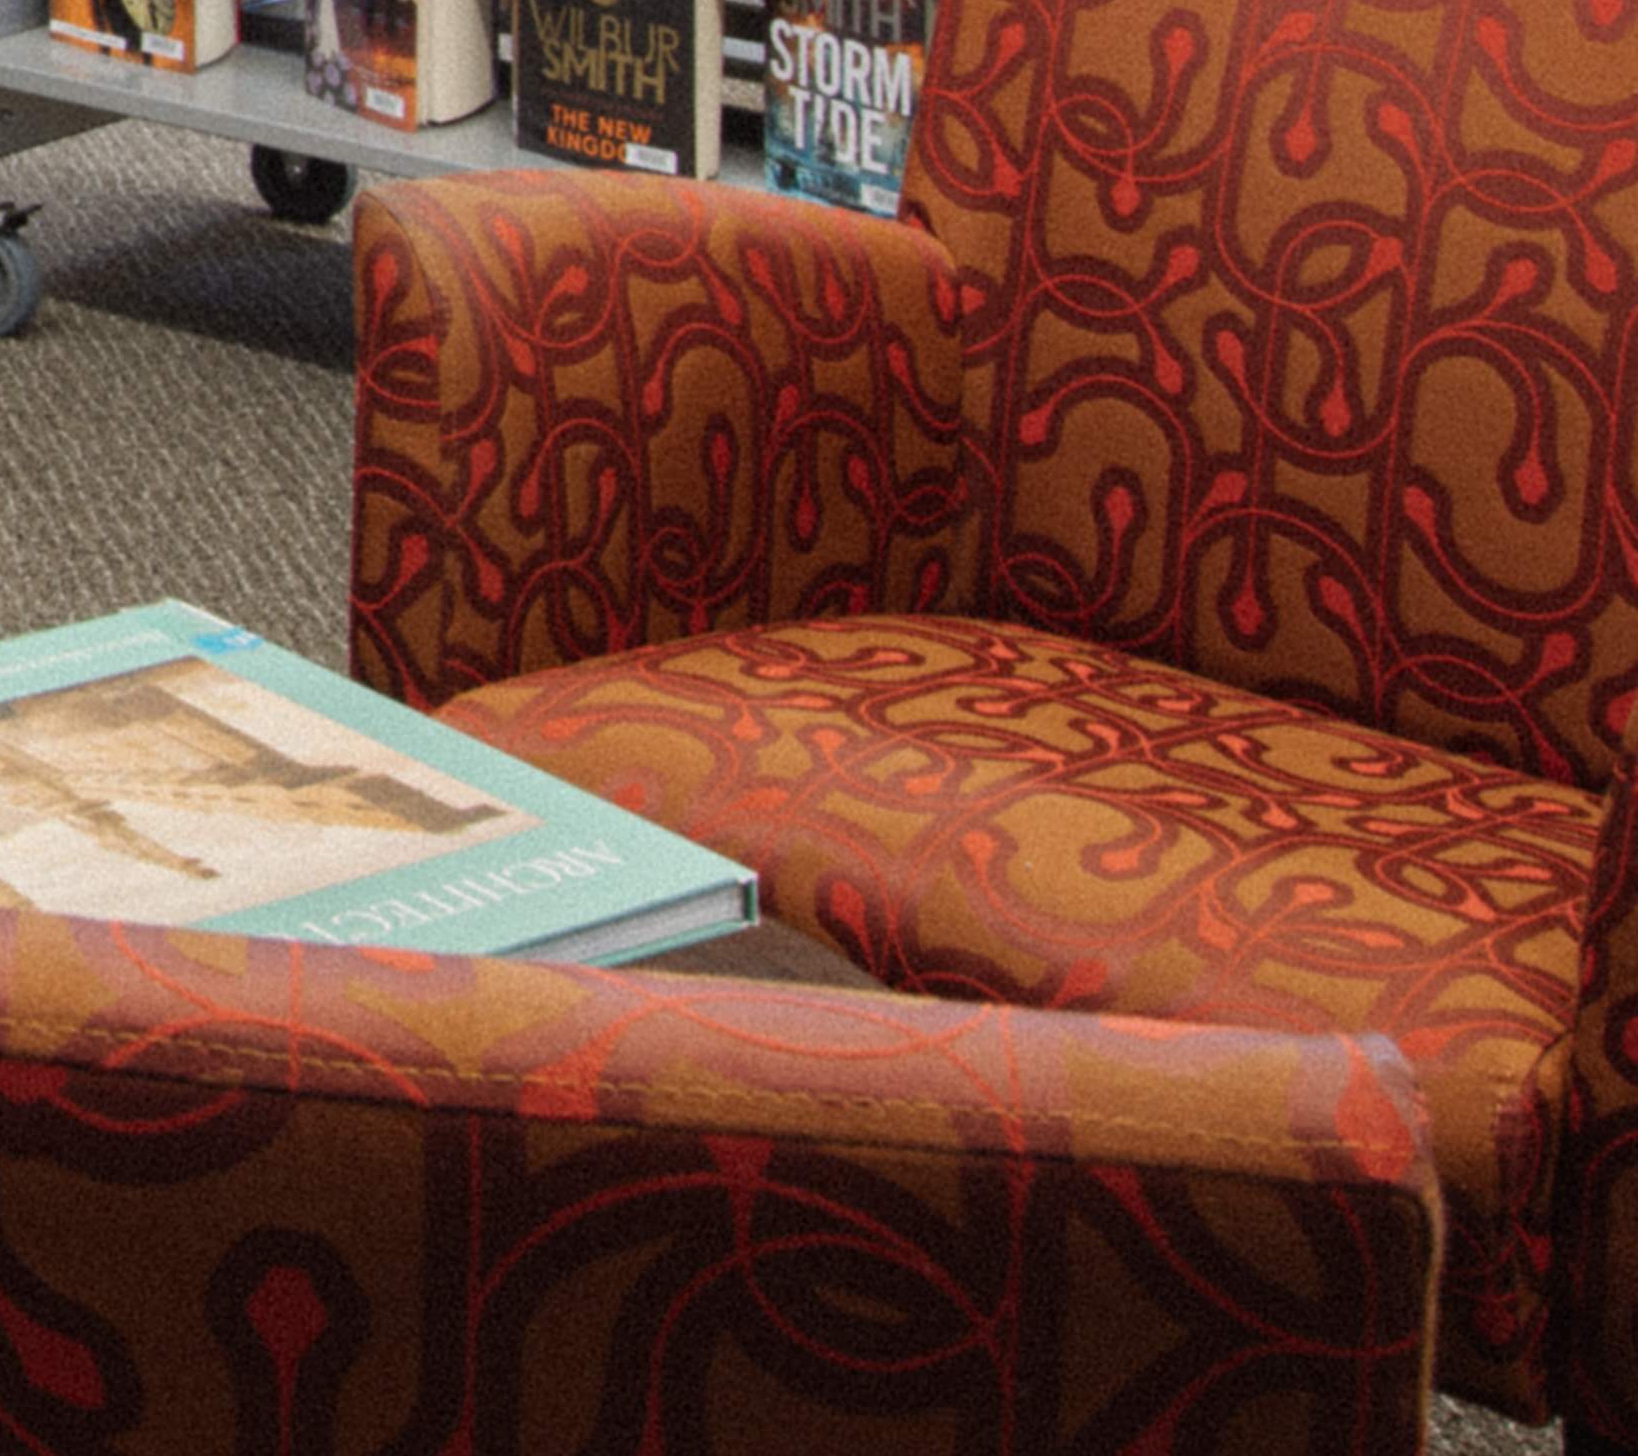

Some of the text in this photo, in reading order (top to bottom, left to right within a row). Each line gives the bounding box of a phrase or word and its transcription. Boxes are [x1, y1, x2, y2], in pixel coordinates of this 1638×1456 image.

[541, 43, 668, 106] SMITH
[768, 21, 915, 117] STORM
[791, 94, 888, 175] TIDE
